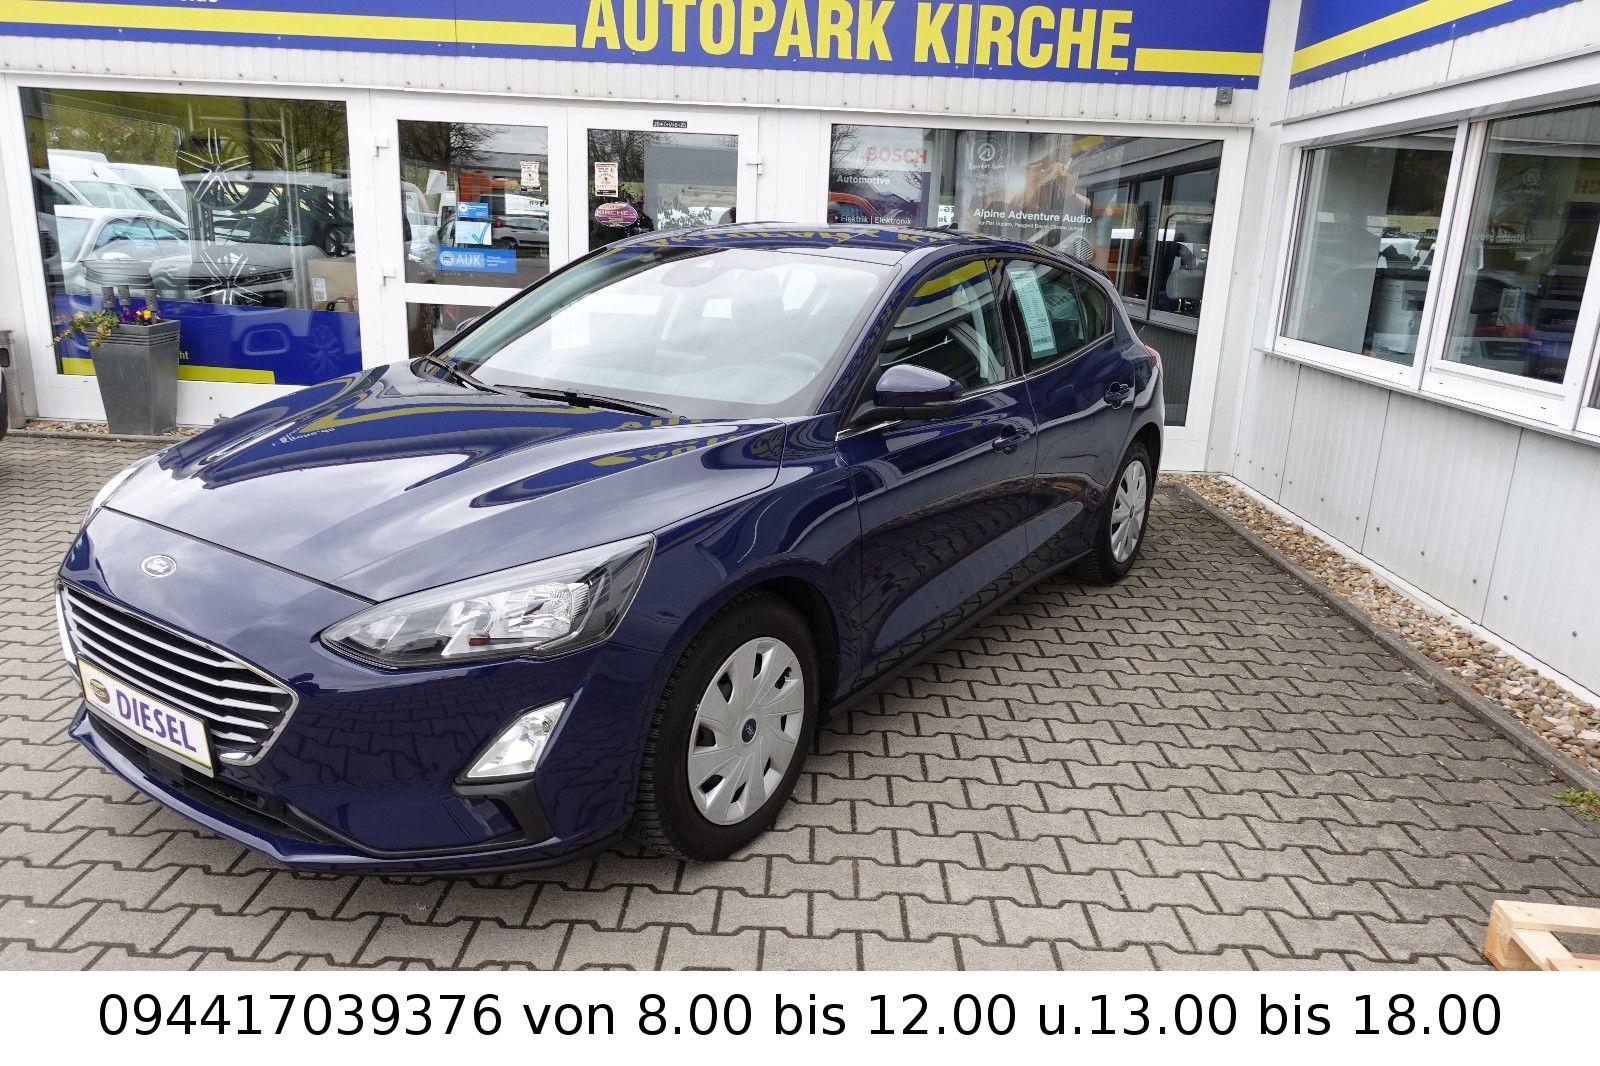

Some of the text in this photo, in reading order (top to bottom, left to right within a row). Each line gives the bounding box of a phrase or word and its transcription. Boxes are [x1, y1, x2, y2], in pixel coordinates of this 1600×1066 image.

[581, 0, 1133, 70] AUTOPARK KIRCHE
[865, 146, 928, 164] BOSCH
[836, 174, 890, 185] Automotive
[840, 215, 912, 225] Elektrik Elektronik
[973, 208, 1093, 224] Alpine Adventure Audio
[456, 253, 482, 268] AUK
[115, 688, 198, 753] DIESEL
